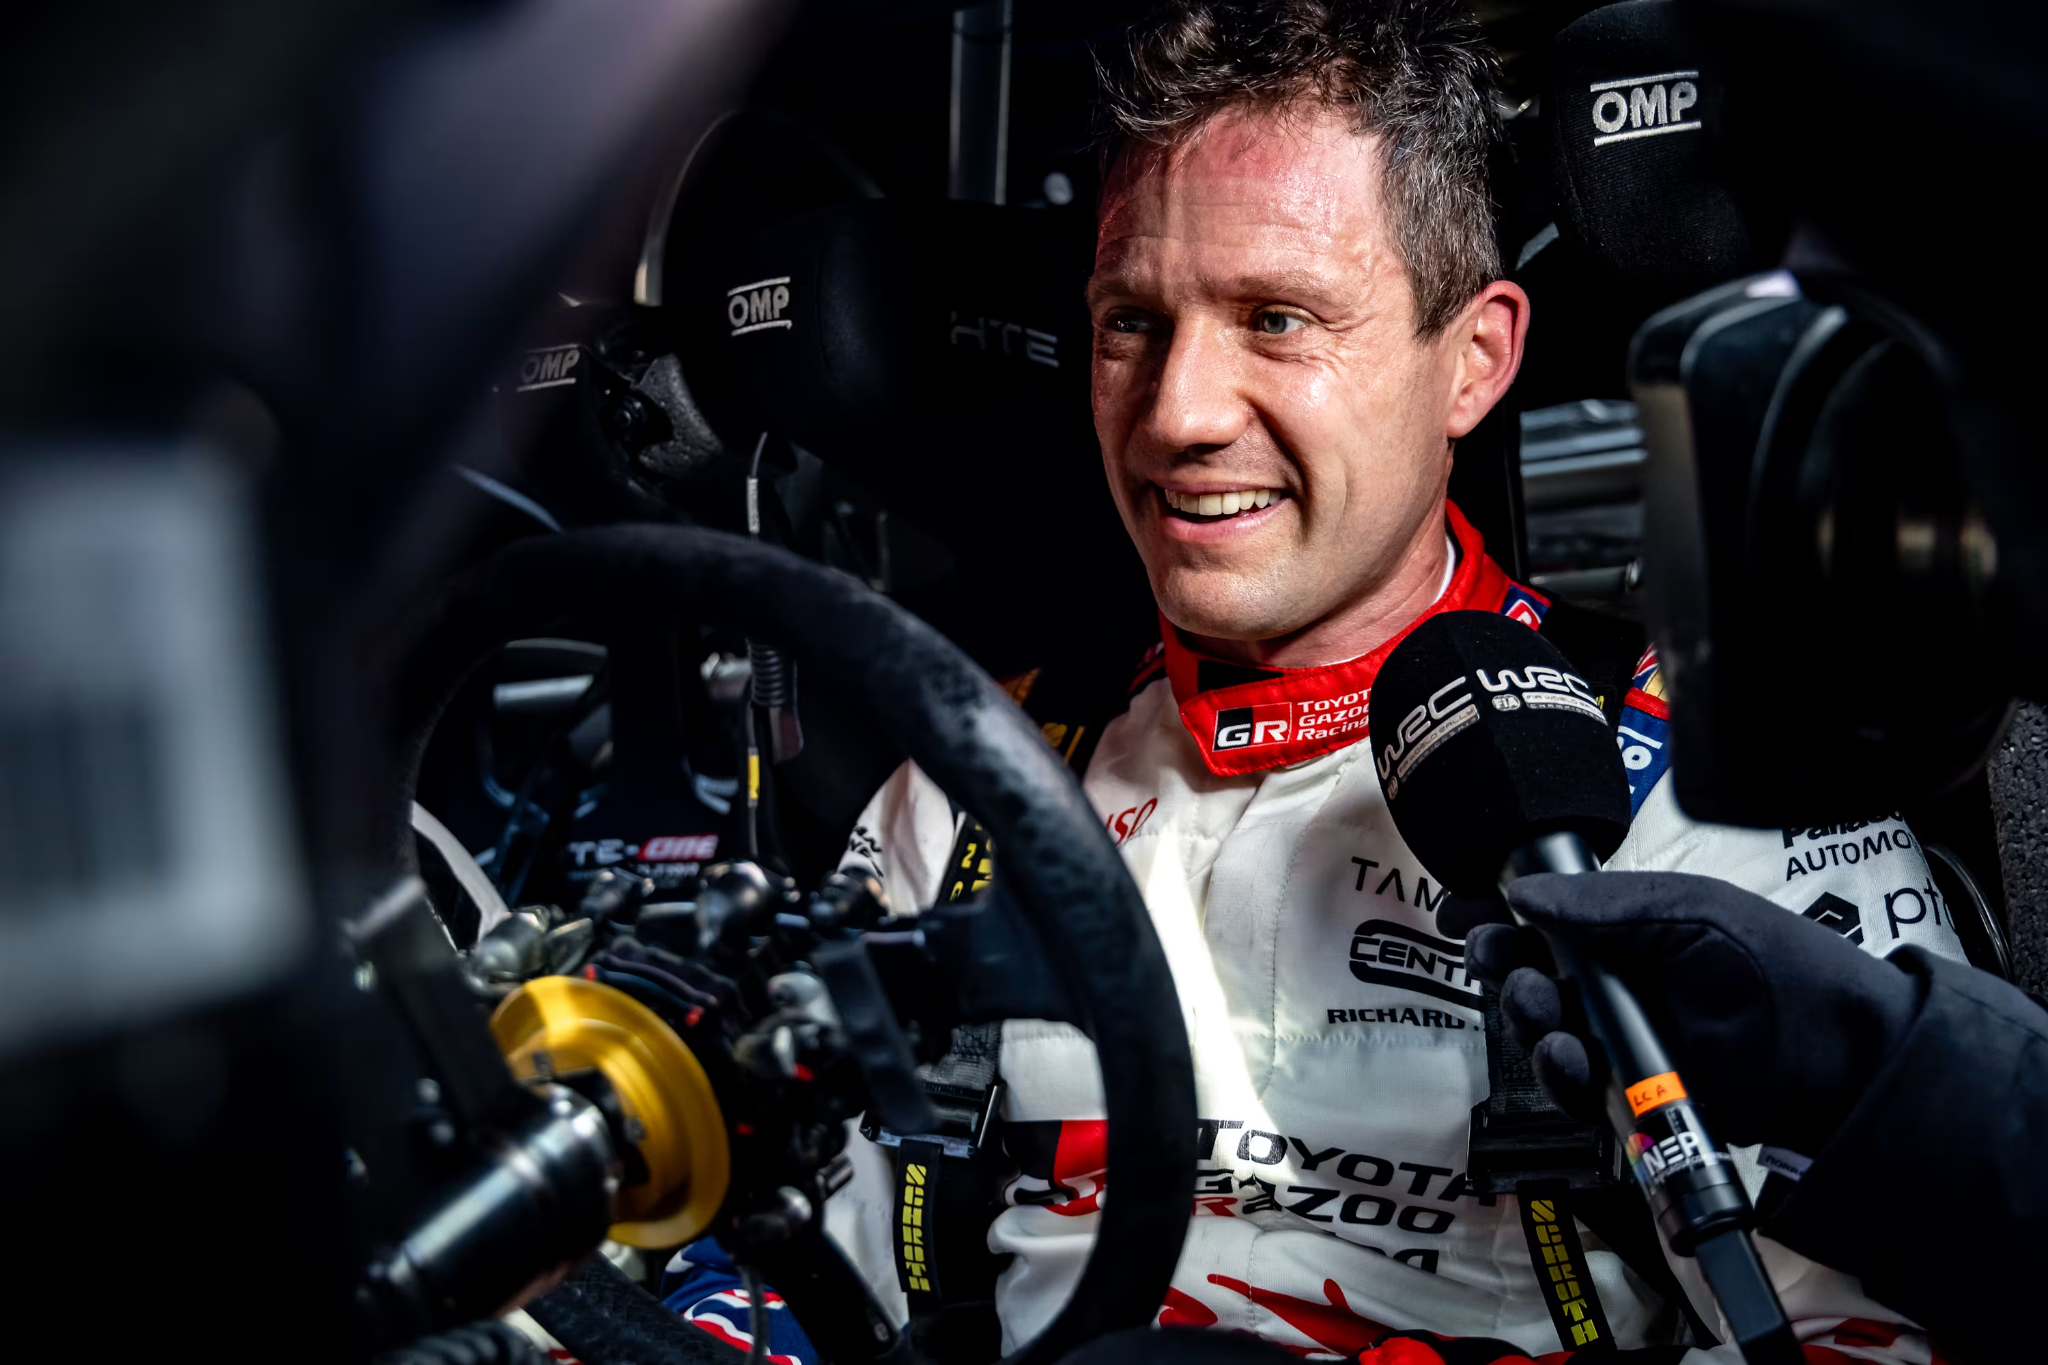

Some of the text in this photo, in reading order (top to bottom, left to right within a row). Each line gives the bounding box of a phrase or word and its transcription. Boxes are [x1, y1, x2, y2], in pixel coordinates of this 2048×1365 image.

[1592, 81, 1698, 134] OMP
[727, 285, 790, 328] OMP
[521, 348, 580, 383] OMP
[1476, 665, 1598, 706] WRC
[1217, 719, 1289, 748] GR
[1296, 715, 1369, 741] Racing
[1377, 676, 1472, 780] WRC
[1786, 829, 1920, 881] AUTOMO
[1327, 1007, 1465, 1029] RICHARD
[1196, 1118, 1497, 1208] TOYOTA
[1642, 1131, 1699, 1177] NEP
[902, 1163, 931, 1292] SCHROTH
[1531, 1199, 1599, 1347] SCHROTH
